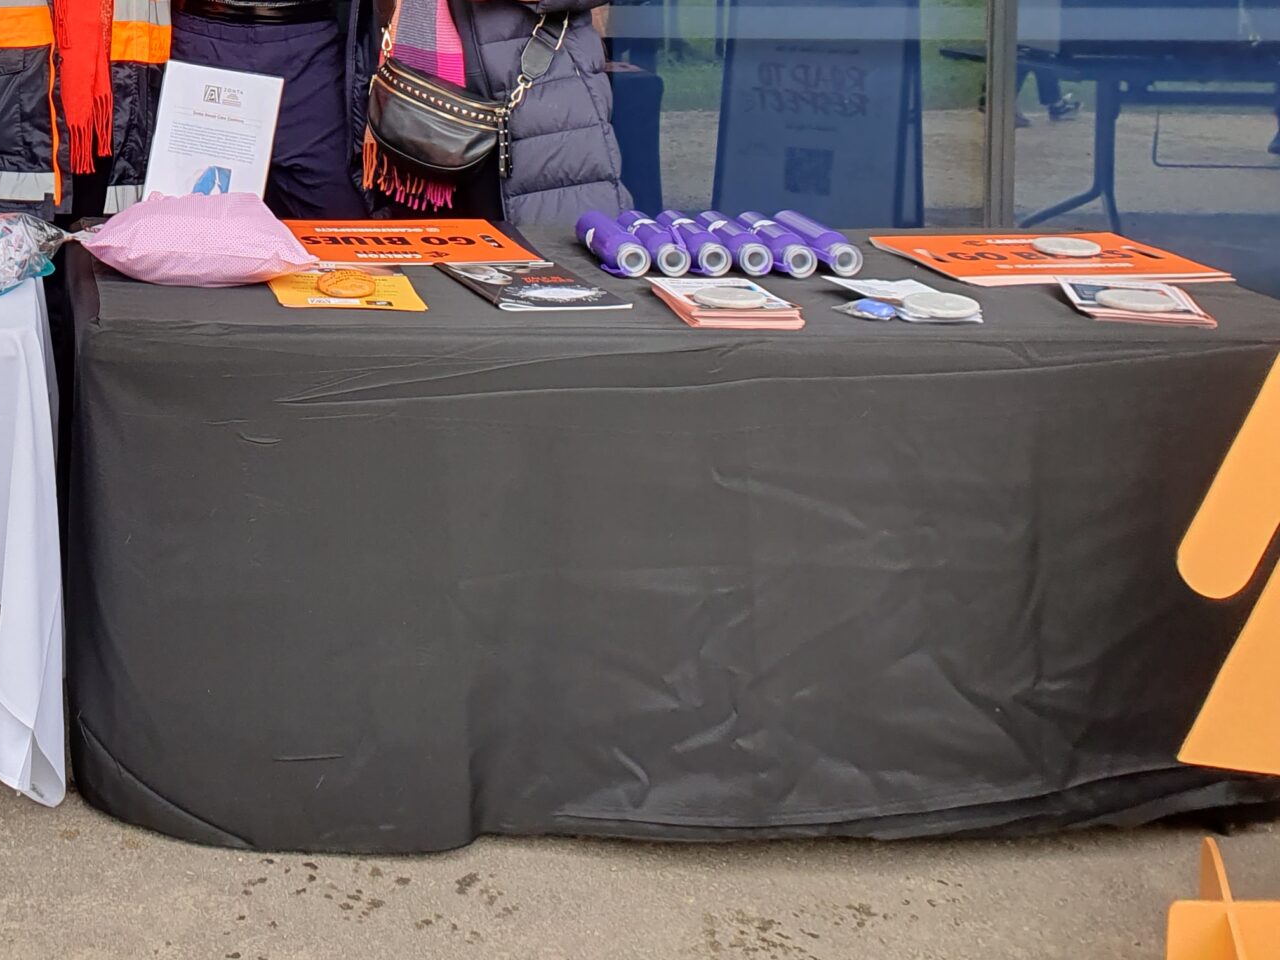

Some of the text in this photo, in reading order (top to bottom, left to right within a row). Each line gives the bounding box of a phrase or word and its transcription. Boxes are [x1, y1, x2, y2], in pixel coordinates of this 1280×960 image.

[301, 236, 476, 246] GO BLUES
[947, 251, 1008, 261] GO
